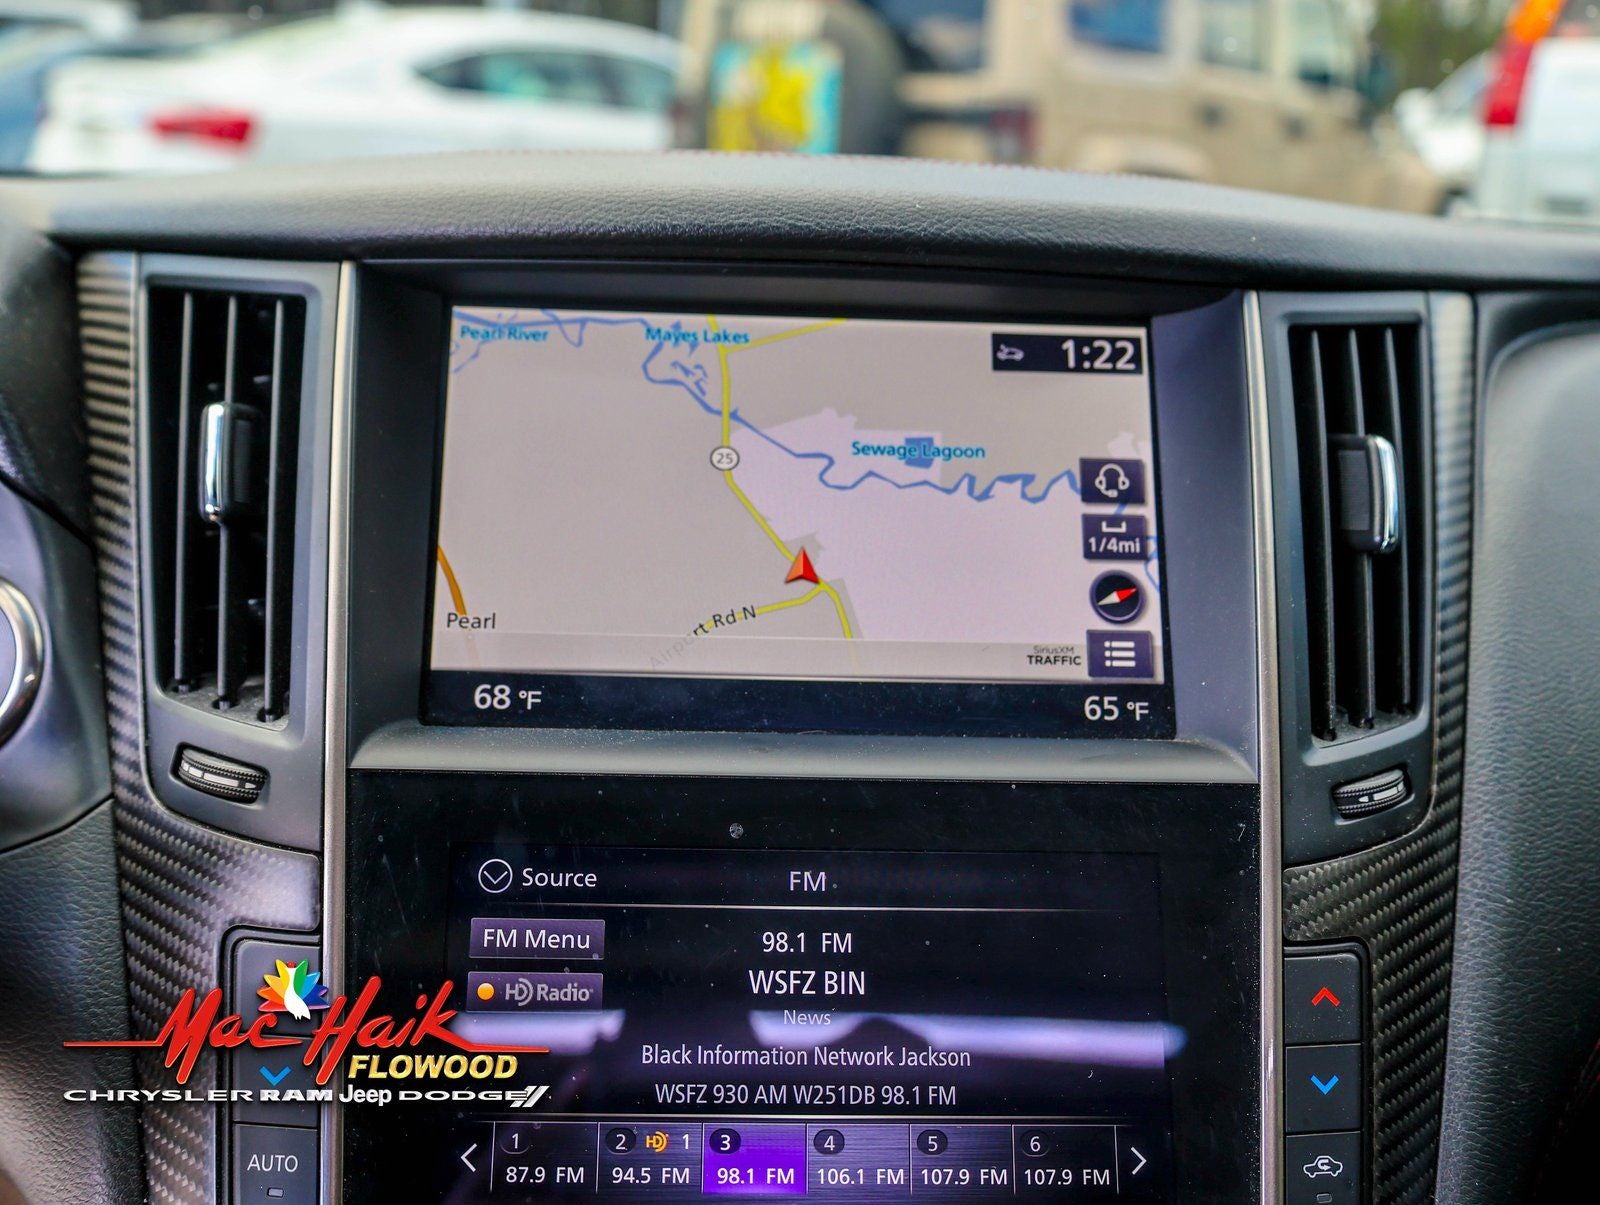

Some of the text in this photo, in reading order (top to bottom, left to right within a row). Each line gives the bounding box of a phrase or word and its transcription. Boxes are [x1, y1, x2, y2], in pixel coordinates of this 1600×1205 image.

[460, 325, 550, 342] Pearl River
[645, 326, 750, 346] Mayes Lakes
[1061, 339, 1136, 370] 1:22
[716, 452, 733, 464] 25
[852, 441, 985, 461] Sewage Lagoon
[1088, 537, 1140, 553] 1/4mi
[446, 612, 496, 630] Pearl
[712, 608, 737, 628] Rd
[742, 605, 756, 620] N
[1033, 645, 1074, 655] SiriusXM
[1027, 655, 1081, 666] TRAFFIC
[474, 684, 511, 710] 68
[1084, 696, 1119, 721] 65
[522, 867, 597, 887] Source
[789, 871, 826, 892] FM
[483, 928, 590, 949] FM Menu
[762, 931, 852, 953] 98.1 FM
[748, 970, 865, 995] WSFZ BIN
[536, 982, 590, 1002] Radio
[783, 1009, 831, 1025] News
[642, 1044, 971, 1067] Black Information Network Jackson
[655, 1083, 956, 1106] WSFZ 930 AM W251DB 98.1 FM
[511, 1133, 519, 1149] 1
[615, 1134, 626, 1150] 2
[682, 1134, 690, 1150] 1
[720, 1134, 731, 1150] 3
[823, 1135, 835, 1151] 4
[928, 1136, 938, 1151] 5
[1030, 1136, 1041, 1152] 6
[247, 1154, 298, 1173] AUTO
[506, 1166, 584, 1183] 87.9 FM
[612, 1167, 690, 1184] 94.5 FM
[717, 1168, 795, 1184] 98.1 FM
[817, 1168, 905, 1185] 106.1 FM
[921, 1168, 1007, 1185] 107.9 FM
[1024, 1169, 1110, 1185] 107.9 FM
